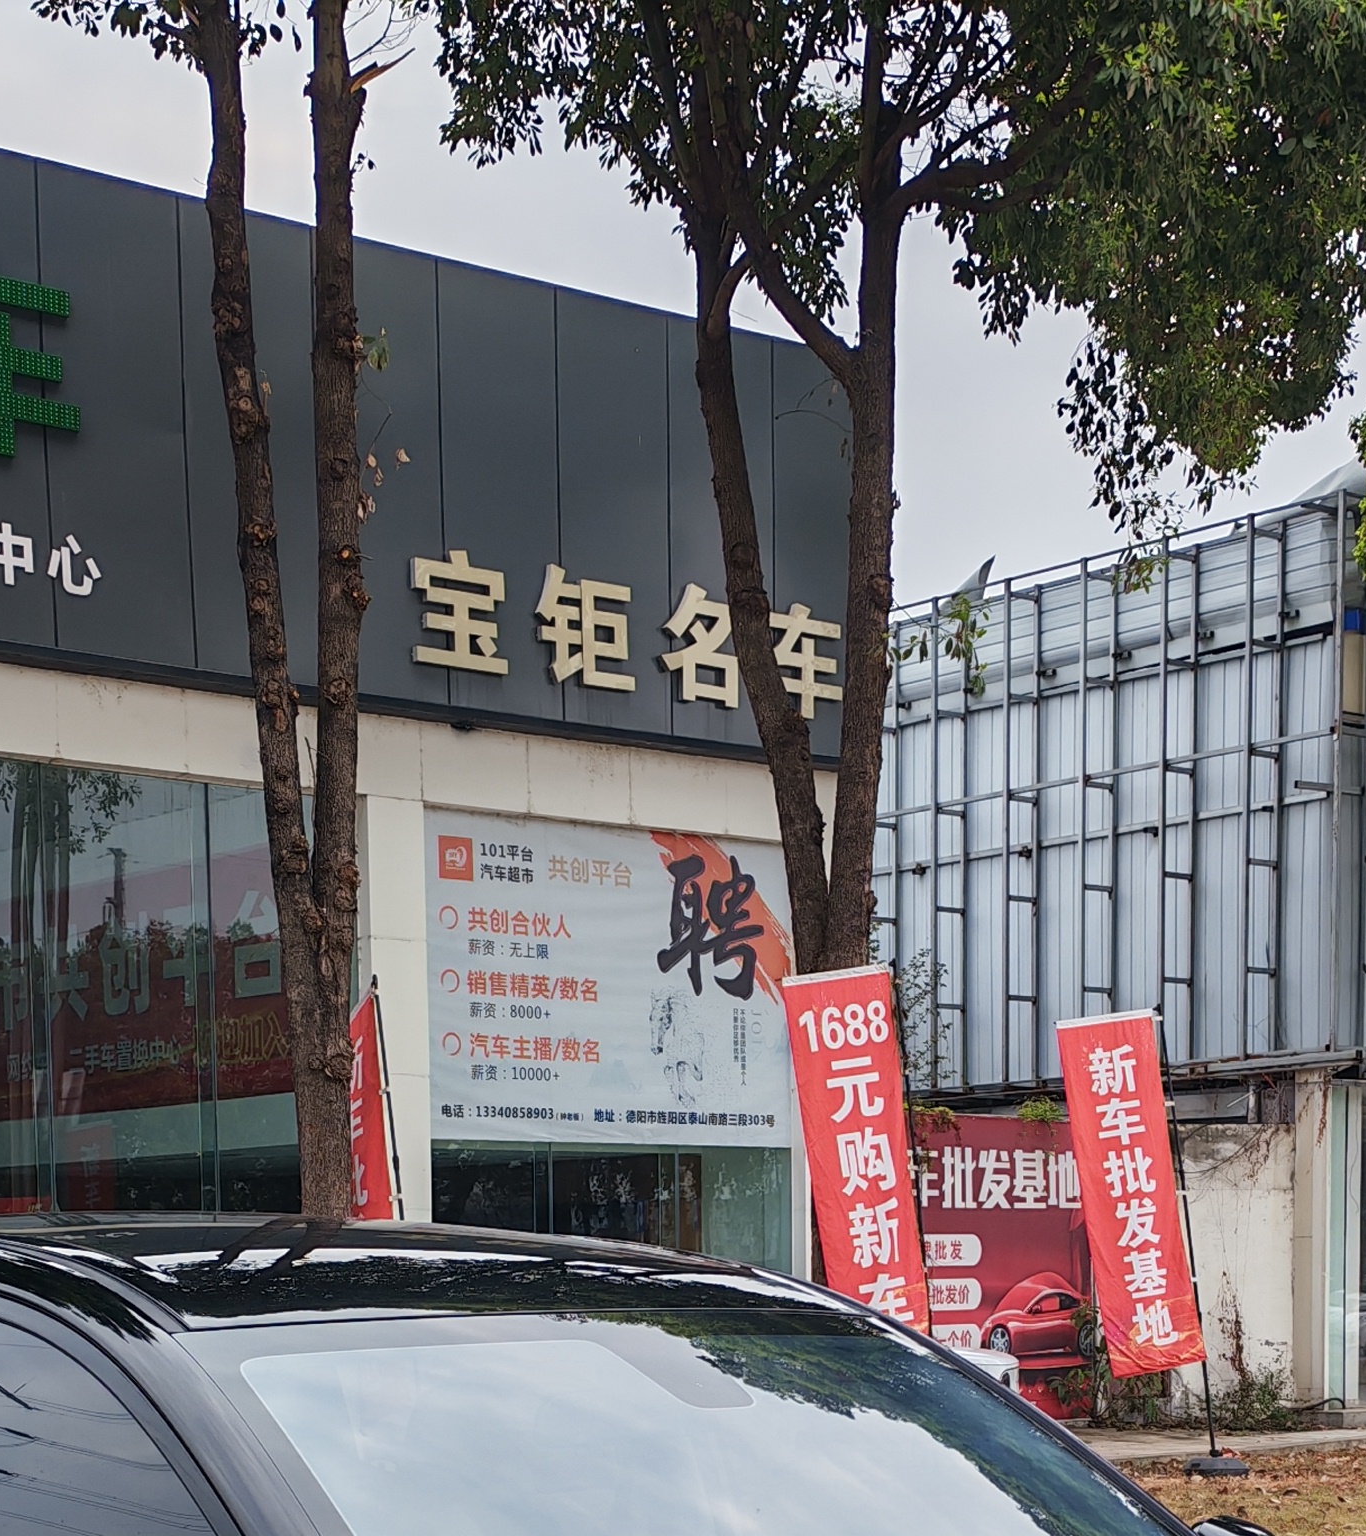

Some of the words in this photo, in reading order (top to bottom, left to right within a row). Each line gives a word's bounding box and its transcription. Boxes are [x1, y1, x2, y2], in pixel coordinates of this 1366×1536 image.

[409, 549, 845, 721] 宝钜名车
[480, 843, 533, 863] 101平台
[480, 863, 534, 884] 汽车超市
[548, 855, 632, 889] 共创平台
[467, 907, 572, 939] 共创合伙人
[656, 854, 765, 1001] 聘
[467, 969, 599, 1003] 销售精英/数名
[470, 1032, 600, 1064] 汽车主播/数名
[1086, 1043, 1179, 1348] 新车批发基地
[928, 1283, 970, 1305] 批发价
